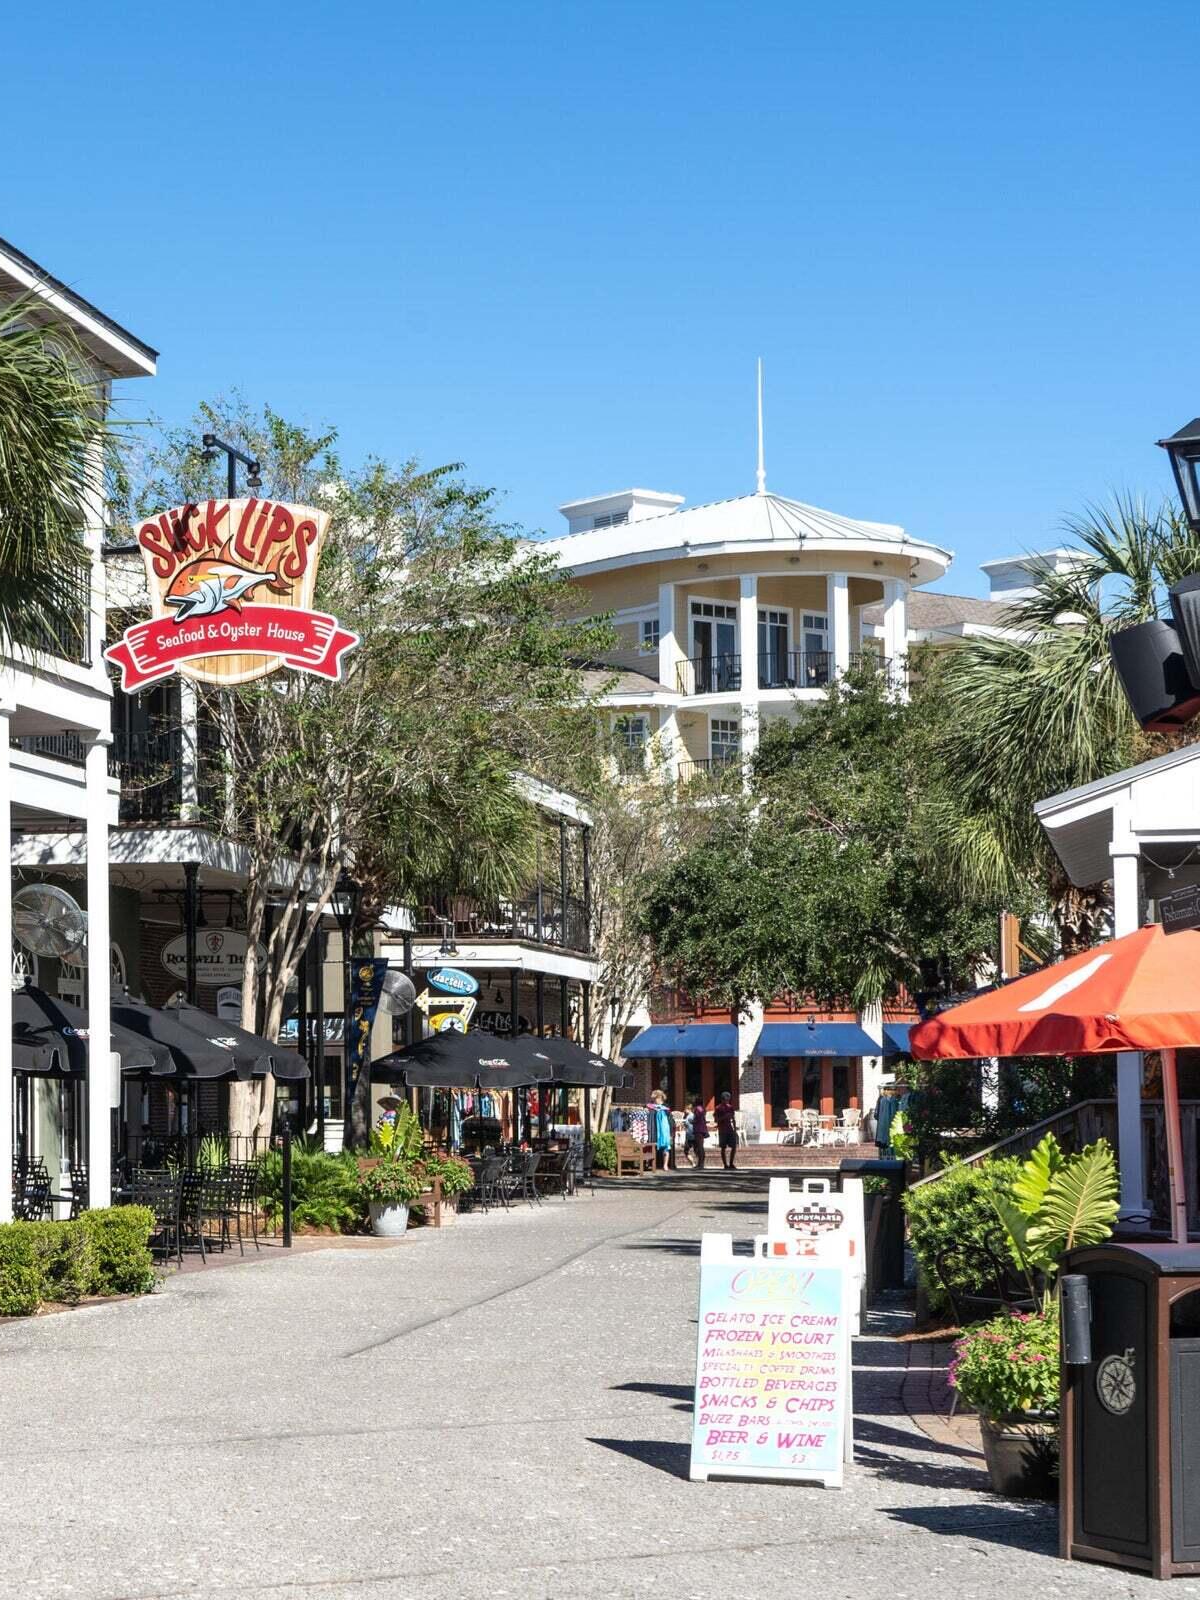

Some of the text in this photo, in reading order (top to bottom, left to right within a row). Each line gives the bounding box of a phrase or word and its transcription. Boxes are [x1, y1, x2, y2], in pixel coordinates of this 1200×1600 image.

[156, 622, 306, 650] Seafood & Oyster House
[166, 953, 224, 965] ROCWELL
[787, 1214, 842, 1222] CANDYMAKER
[704, 1312, 838, 1328] GELATO ICE CREAM
[704, 1329, 835, 1345] FROZEN YOGURT
[779, 1350, 837, 1361] SMOOTHIES
[799, 1365, 836, 1376] DRINKS
[699, 1376, 838, 1392] BOTTLED BEVERAGES
[699, 1393, 837, 1413] SNACKS & CHIPS
[699, 1412, 734, 1425] BUZZ
[737, 1414, 771, 1427] BARS
[705, 1429, 827, 1448] BEER & WINE
